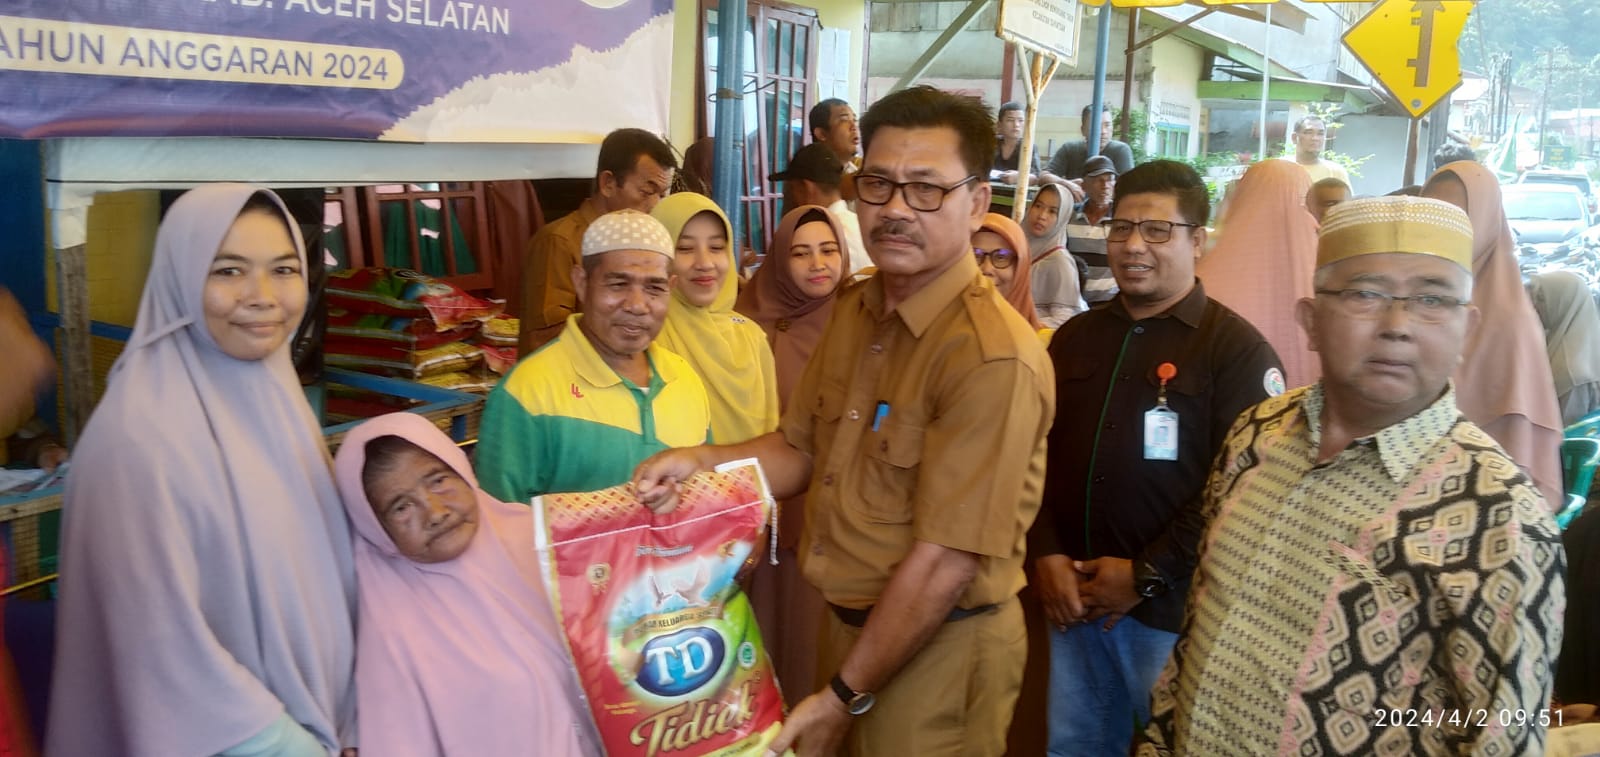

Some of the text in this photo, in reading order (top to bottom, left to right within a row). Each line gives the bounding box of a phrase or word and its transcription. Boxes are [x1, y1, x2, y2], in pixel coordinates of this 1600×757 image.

[386, 0, 509, 34] SELATAN
[119, 36, 313, 77] ANGGARAN
[323, 52, 388, 81] 2024
[646, 636, 713, 685] TD
